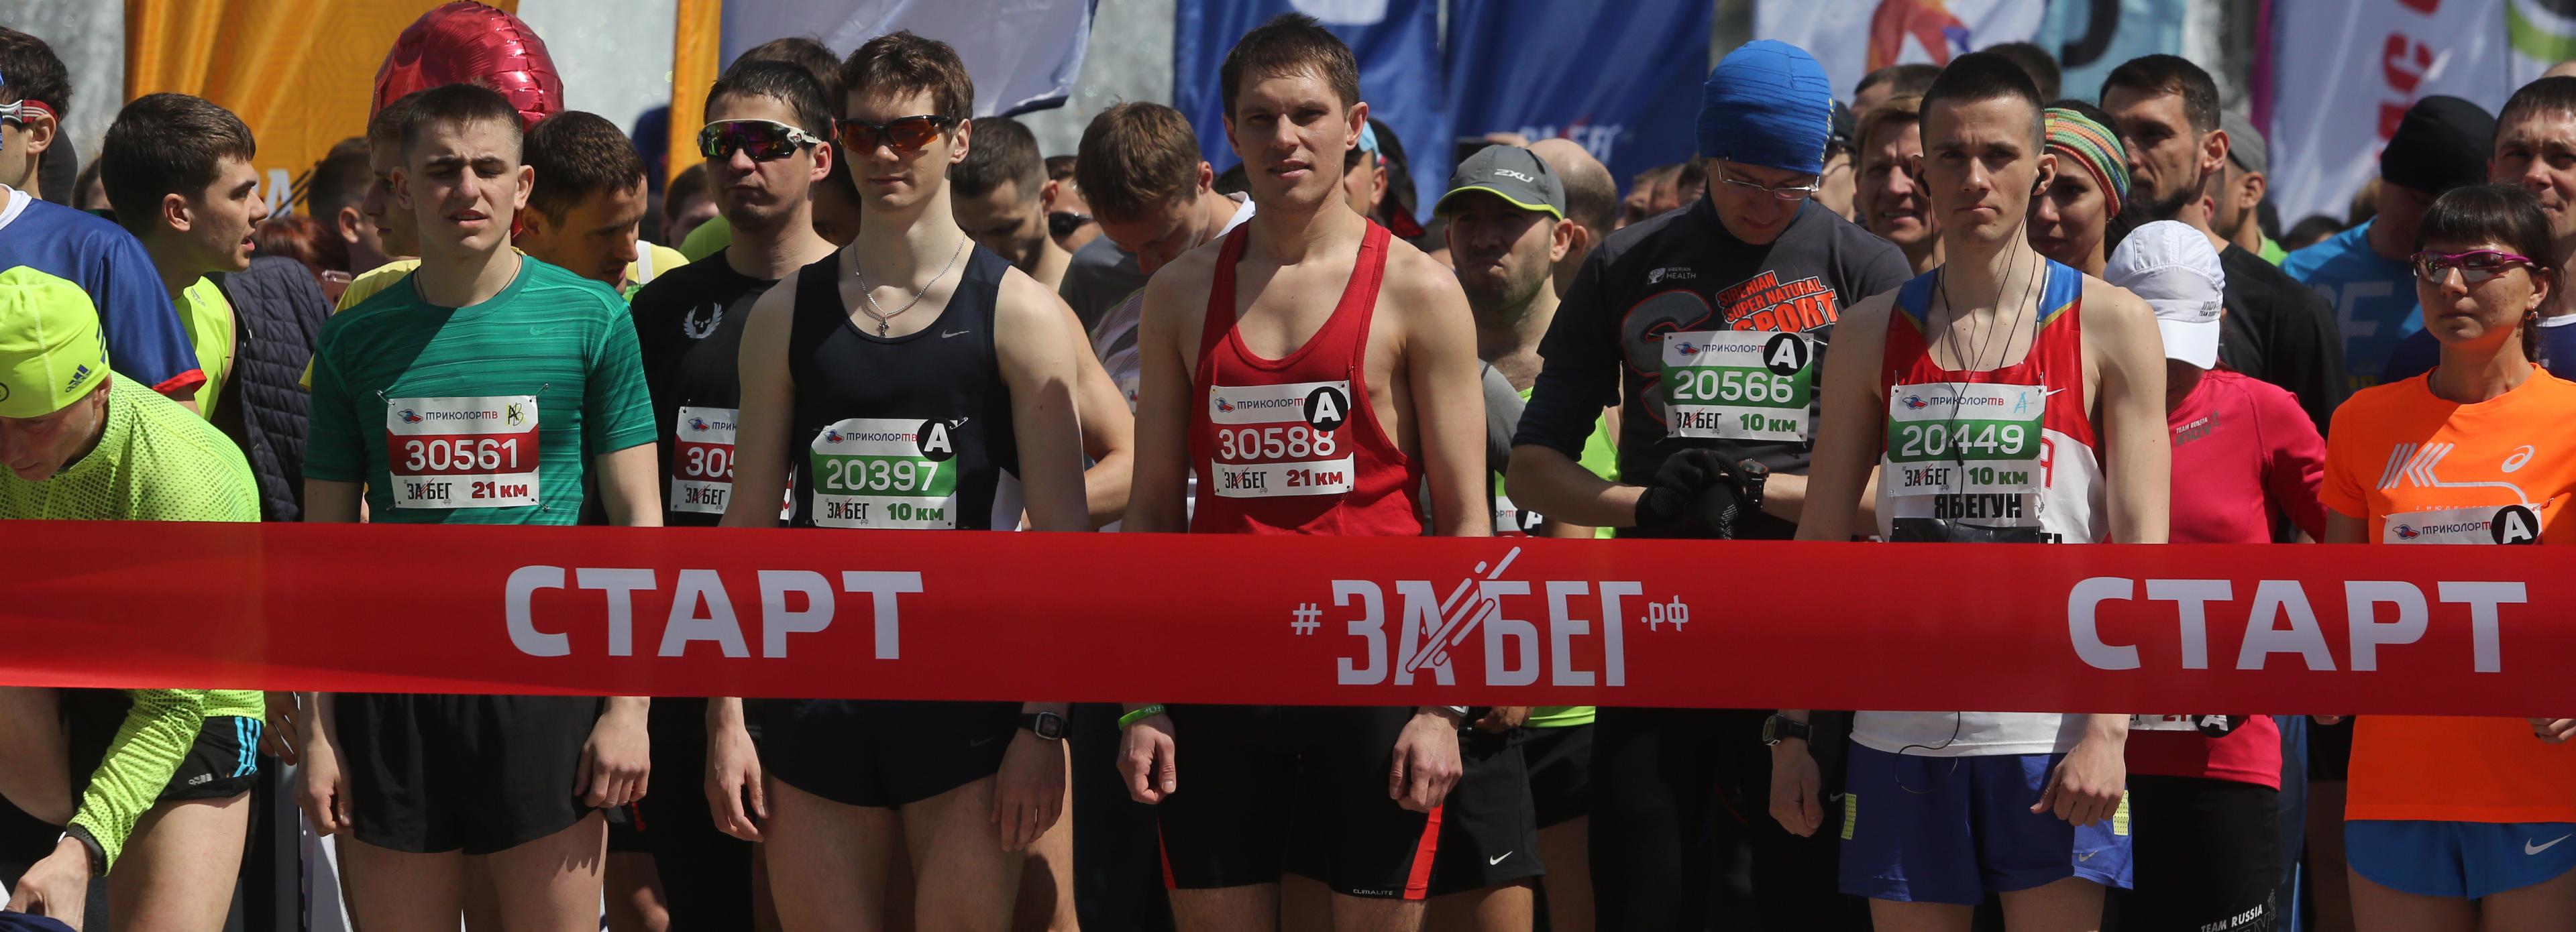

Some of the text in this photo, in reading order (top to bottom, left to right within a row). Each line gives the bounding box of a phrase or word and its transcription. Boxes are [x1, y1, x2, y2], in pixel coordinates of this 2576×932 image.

[1495, 169, 1534, 182] 2XU
[1717, 271, 1777, 306] SIBERIAN
[1724, 278, 1825, 321] SUPER NATURAL
[1733, 290, 1838, 333] SPORT
[1673, 369, 1793, 403] 20566
[1237, 398, 1307, 410] ТРИКОЛОРТ
[1739, 414, 1764, 431] 10
[2176, 416, 2208, 434] TEAM RUSSIA
[405, 439, 517, 471] 30561
[1218, 426, 1336, 460] 30588
[1902, 424, 2025, 457] 20449
[472, 481, 496, 499] 21
[826, 459, 939, 491] 20397
[1286, 469, 1311, 487] 21
[1969, 467, 1994, 485] 10
[887, 503, 912, 520] 10
[505, 565, 924, 659] СТАРТ
[2068, 577, 2528, 673] СТАРТ
[2201, 919, 2227, 932] TEAM
[2231, 904, 2263, 927] RUSSIA
